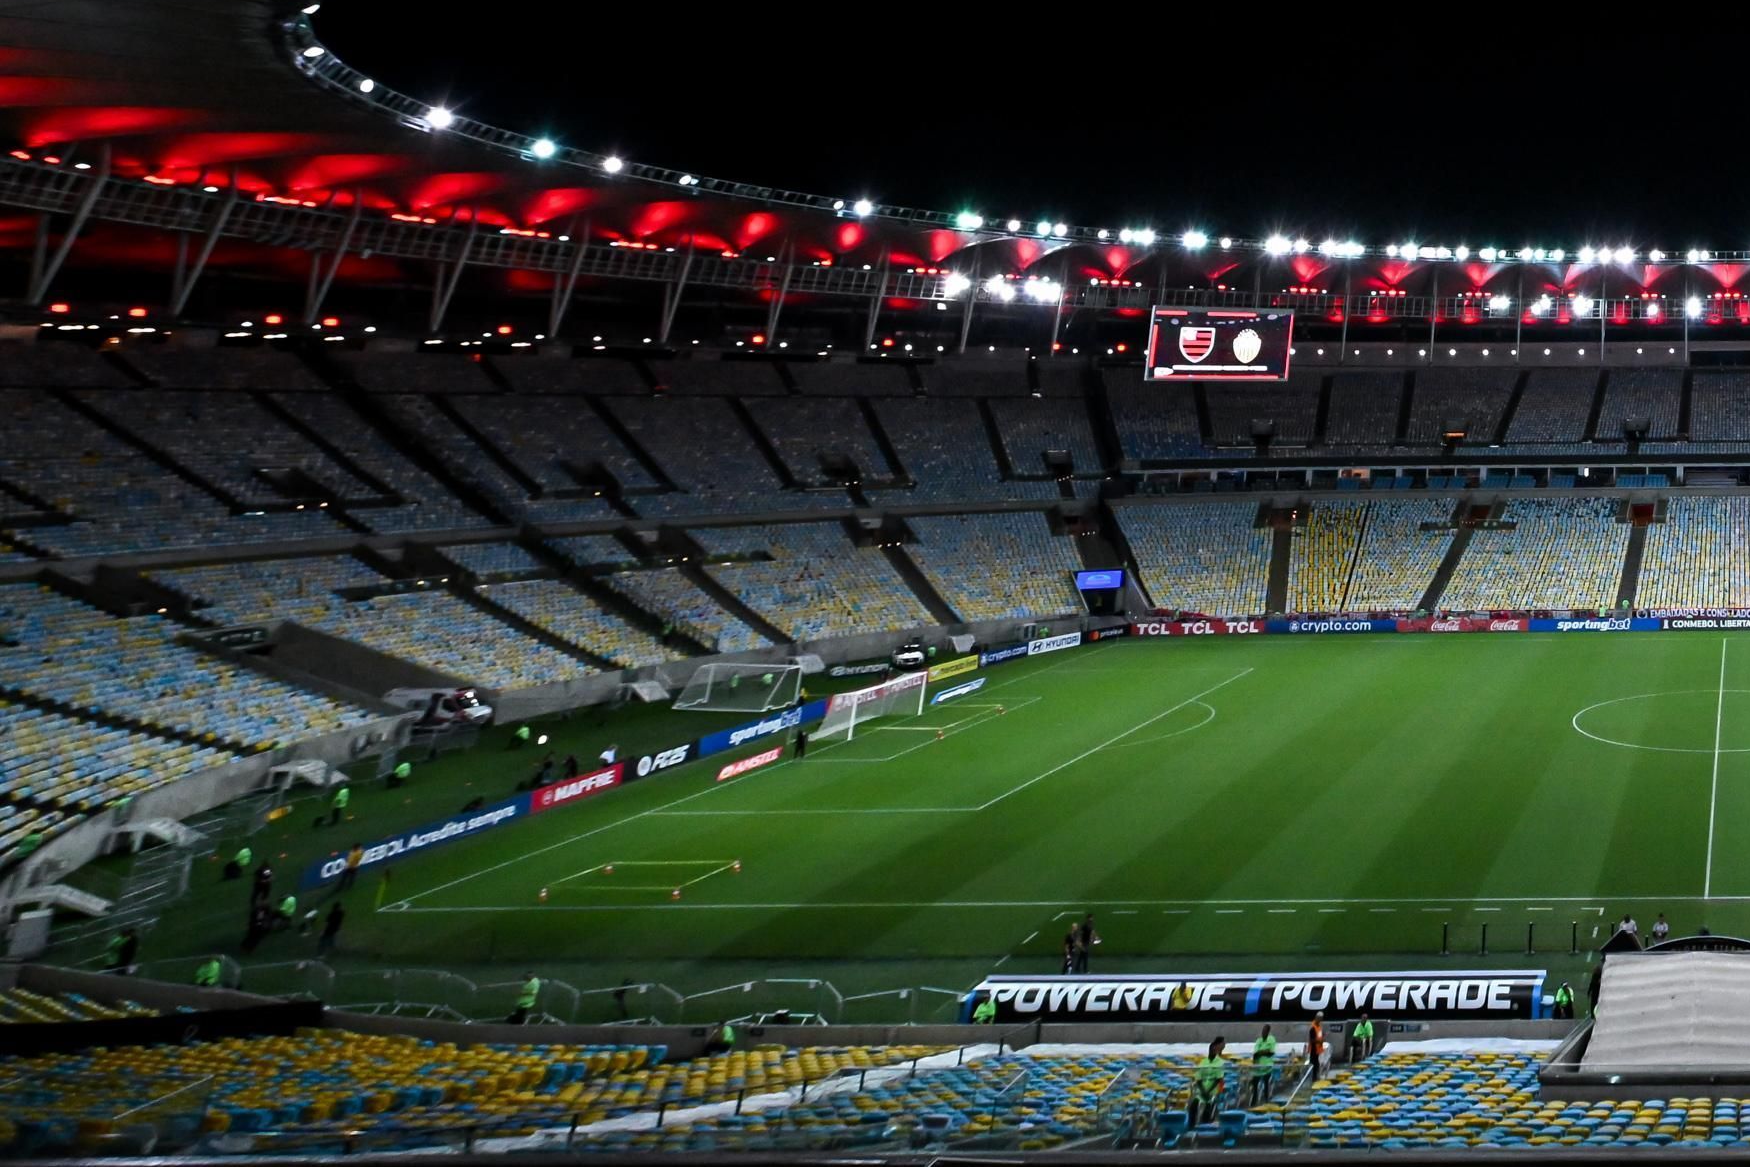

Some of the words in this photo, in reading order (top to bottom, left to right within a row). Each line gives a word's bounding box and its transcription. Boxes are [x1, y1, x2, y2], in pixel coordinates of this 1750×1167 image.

[1137, 623, 1170, 635] TCL
[1181, 622, 1215, 635] TCL
[1225, 621, 1259, 633] TCL
[1301, 620, 1371, 632] crypto.com
[1557, 618, 1630, 631] sportingbet
[1672, 619, 1719, 628] CONMEBOL
[1045, 636, 1079, 649] HYUNDAI
[988, 645, 1027, 661] crypto.com
[554, 769, 616, 802] MAPFRE
[321, 838, 405, 878] COEBOL
[1271, 979, 1516, 1011] POWERADE
